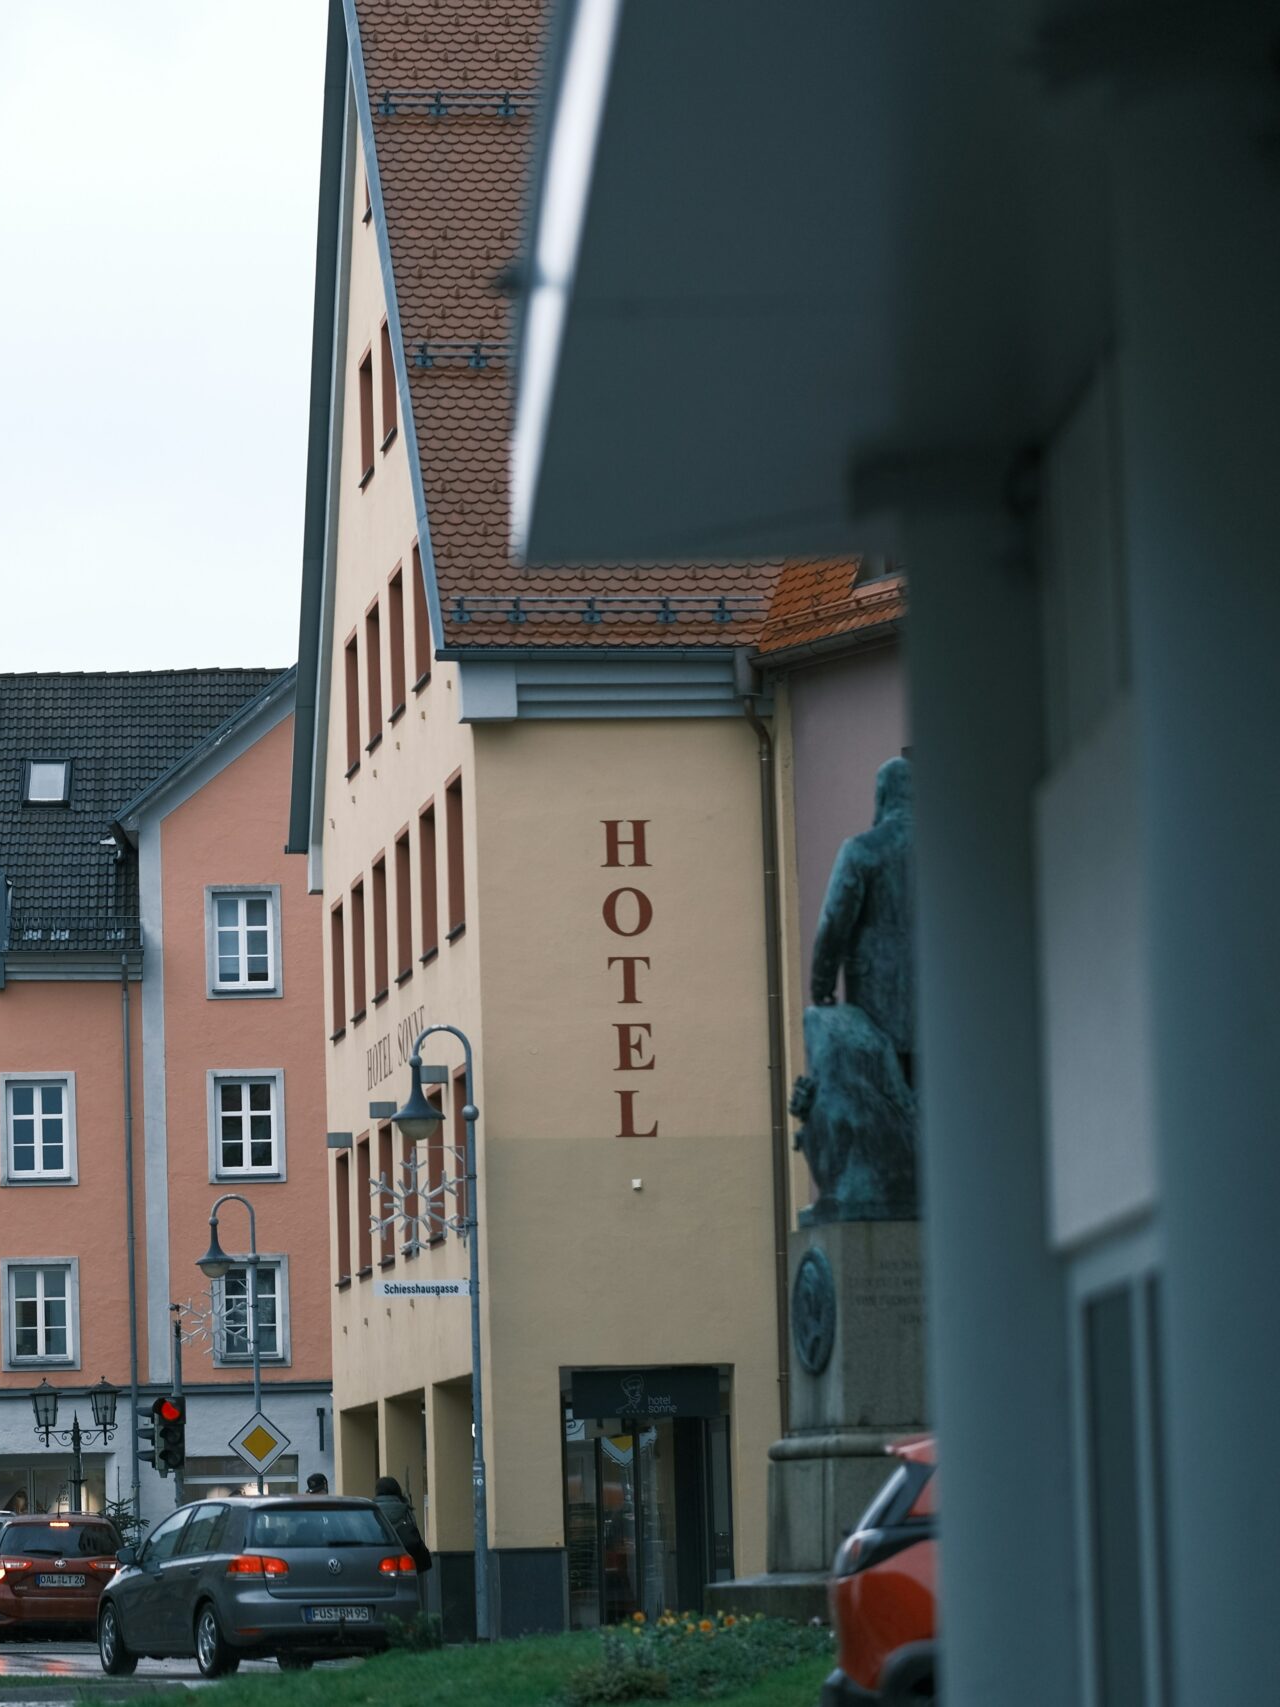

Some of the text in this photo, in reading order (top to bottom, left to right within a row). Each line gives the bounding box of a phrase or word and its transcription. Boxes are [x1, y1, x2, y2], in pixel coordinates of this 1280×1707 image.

[599, 819, 658, 1138] HOTEL
[367, 1033, 393, 1091] HOTEL
[384, 1284, 459, 1296] Schiesshausgasse
[648, 1395, 671, 1405] hotel
[648, 1404, 677, 1413] sonne
